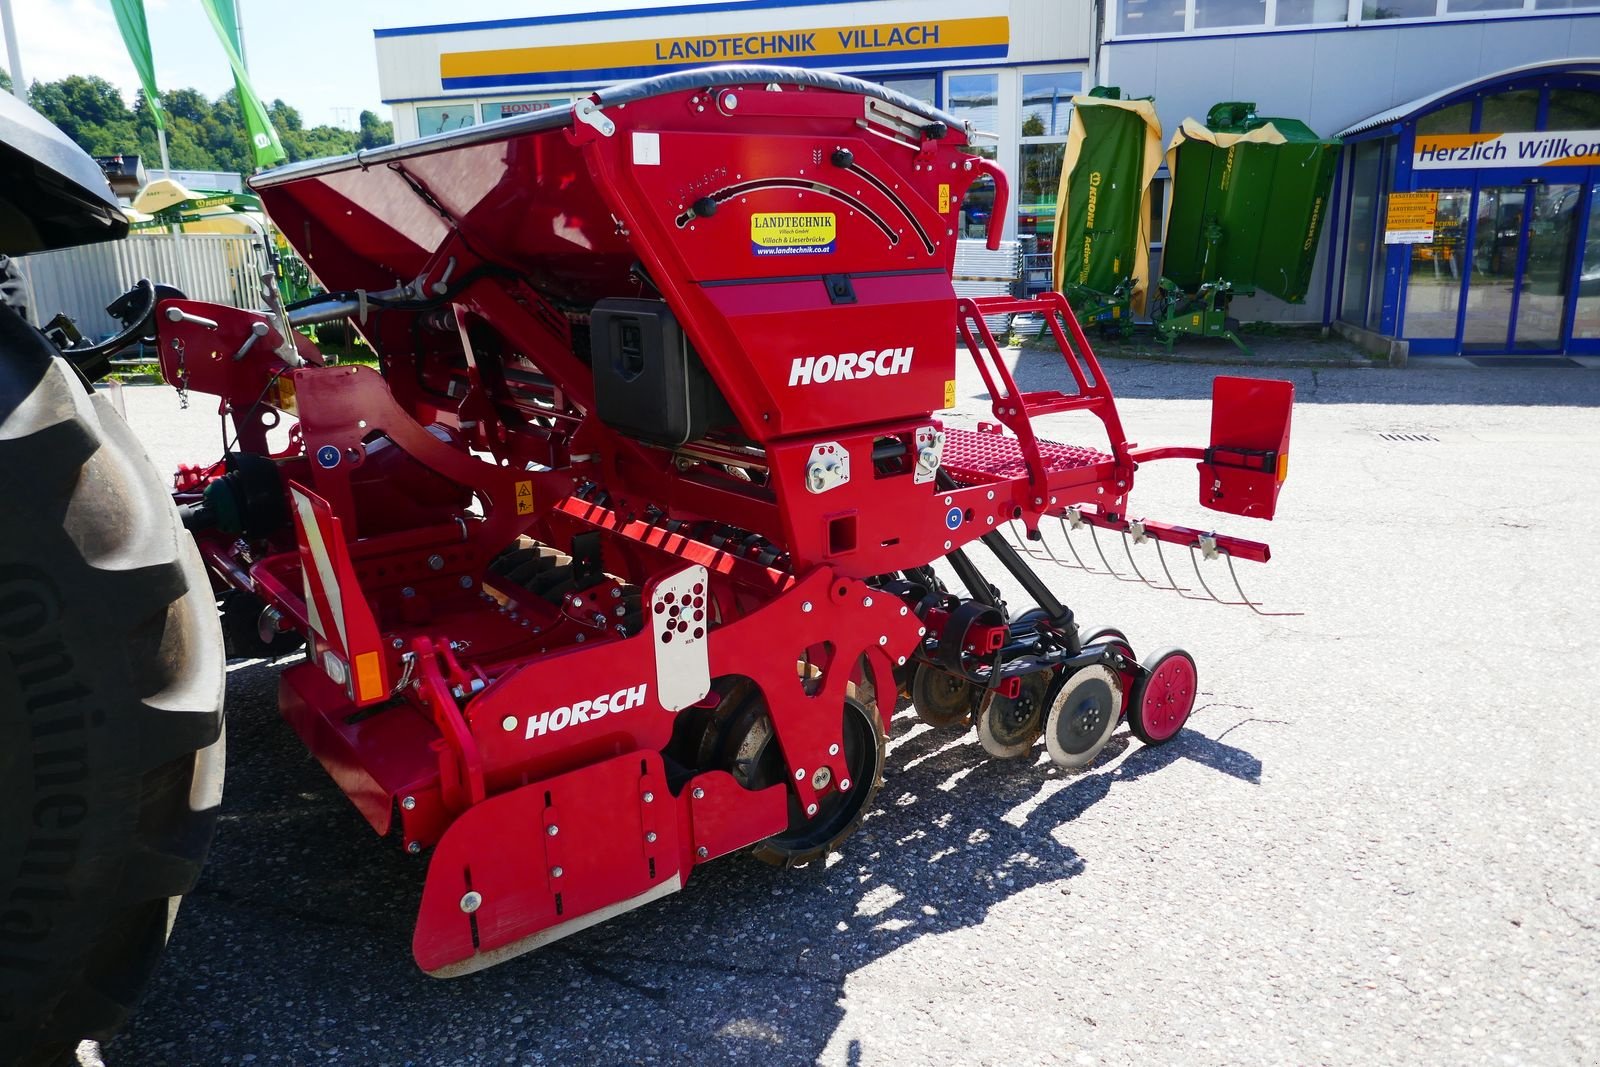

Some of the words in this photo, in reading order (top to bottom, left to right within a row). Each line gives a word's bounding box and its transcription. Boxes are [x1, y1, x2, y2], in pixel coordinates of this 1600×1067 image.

[655, 33, 816, 60] LANDTECHNIK
[838, 25, 939, 49] VILLACH
[501, 103, 551, 113] HONDA
[1419, 140, 1507, 162] Herzlich
[755, 216, 832, 228] LANDTECHNIK
[1087, 187, 1097, 229] KRONE
[757, 246, 830, 255] www.landtechnik.co.at
[788, 347, 914, 387] HORSCH
[525, 684, 647, 740] HORSCH
